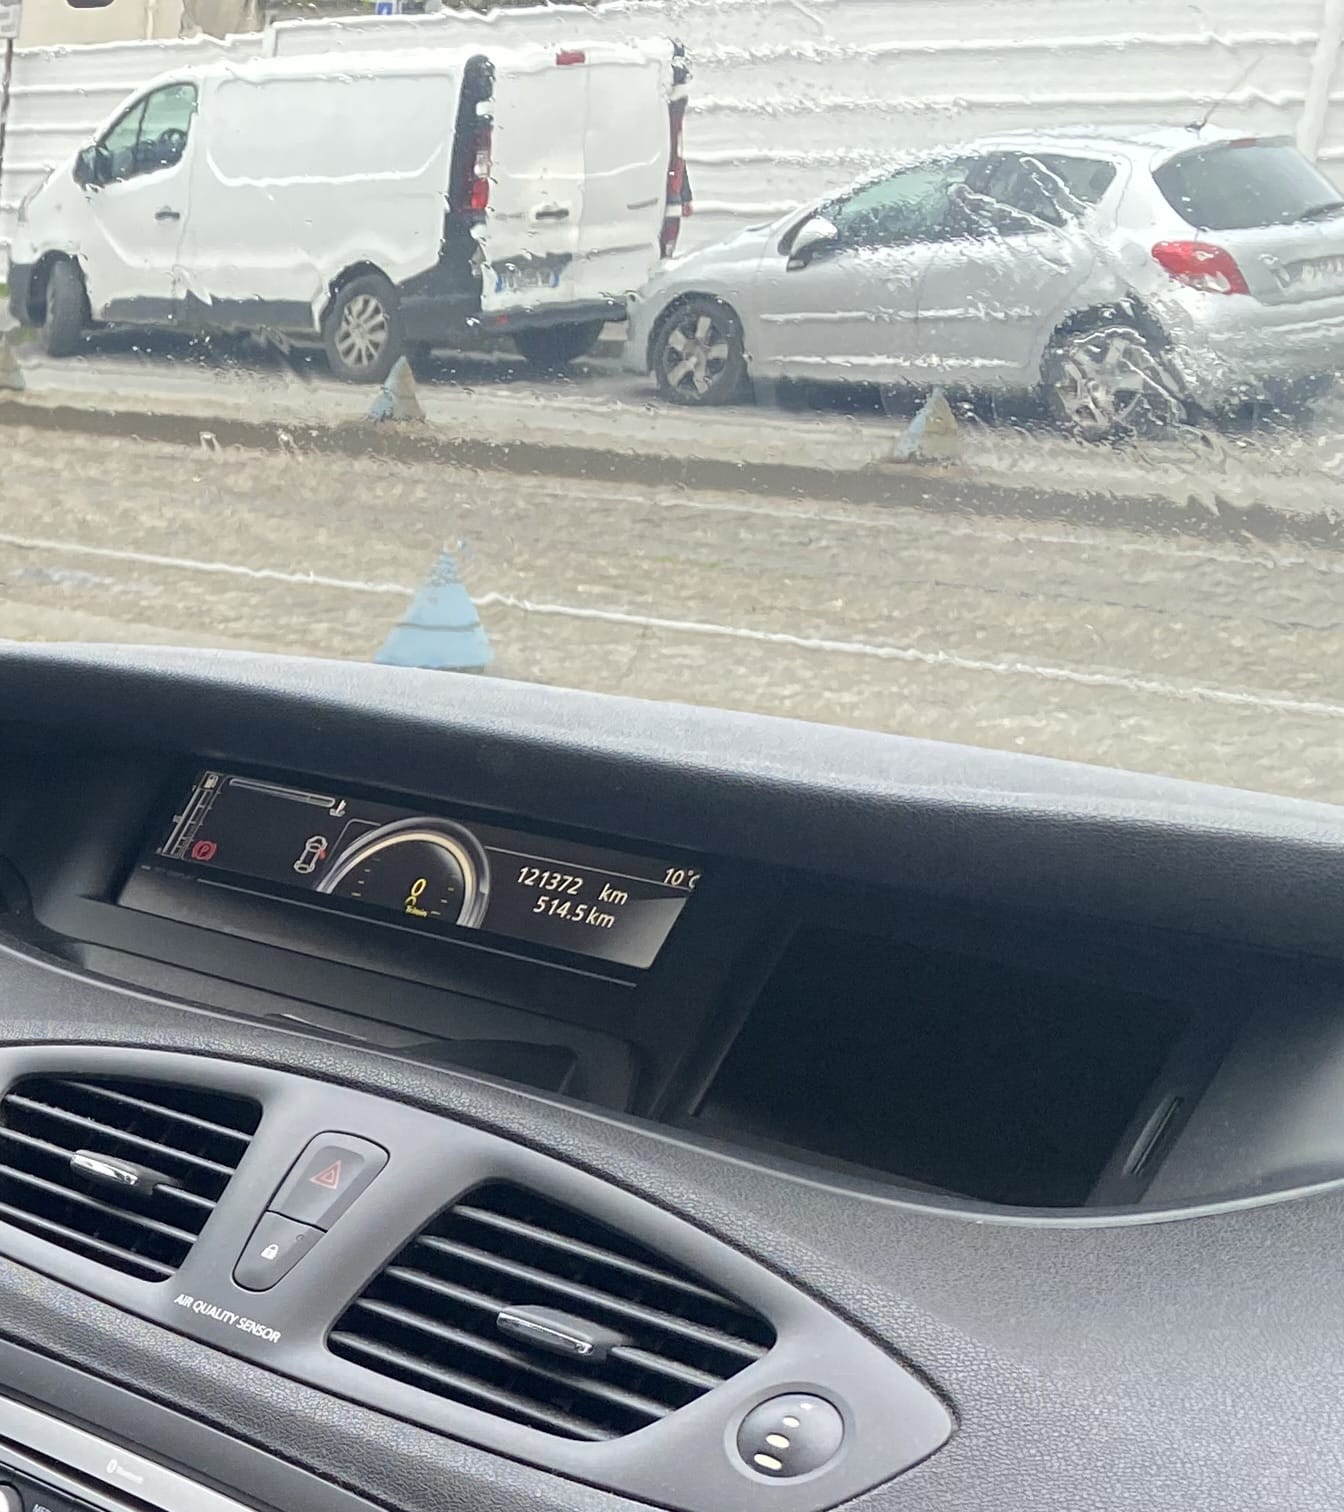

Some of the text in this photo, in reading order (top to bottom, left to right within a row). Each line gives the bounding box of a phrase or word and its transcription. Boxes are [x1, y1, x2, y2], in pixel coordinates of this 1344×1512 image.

[517, 866, 629, 905] 121372 km
[532, 895, 616, 929] 514.5 km
[174, 1294, 281, 1343] AIR QUALITY SENSOR
